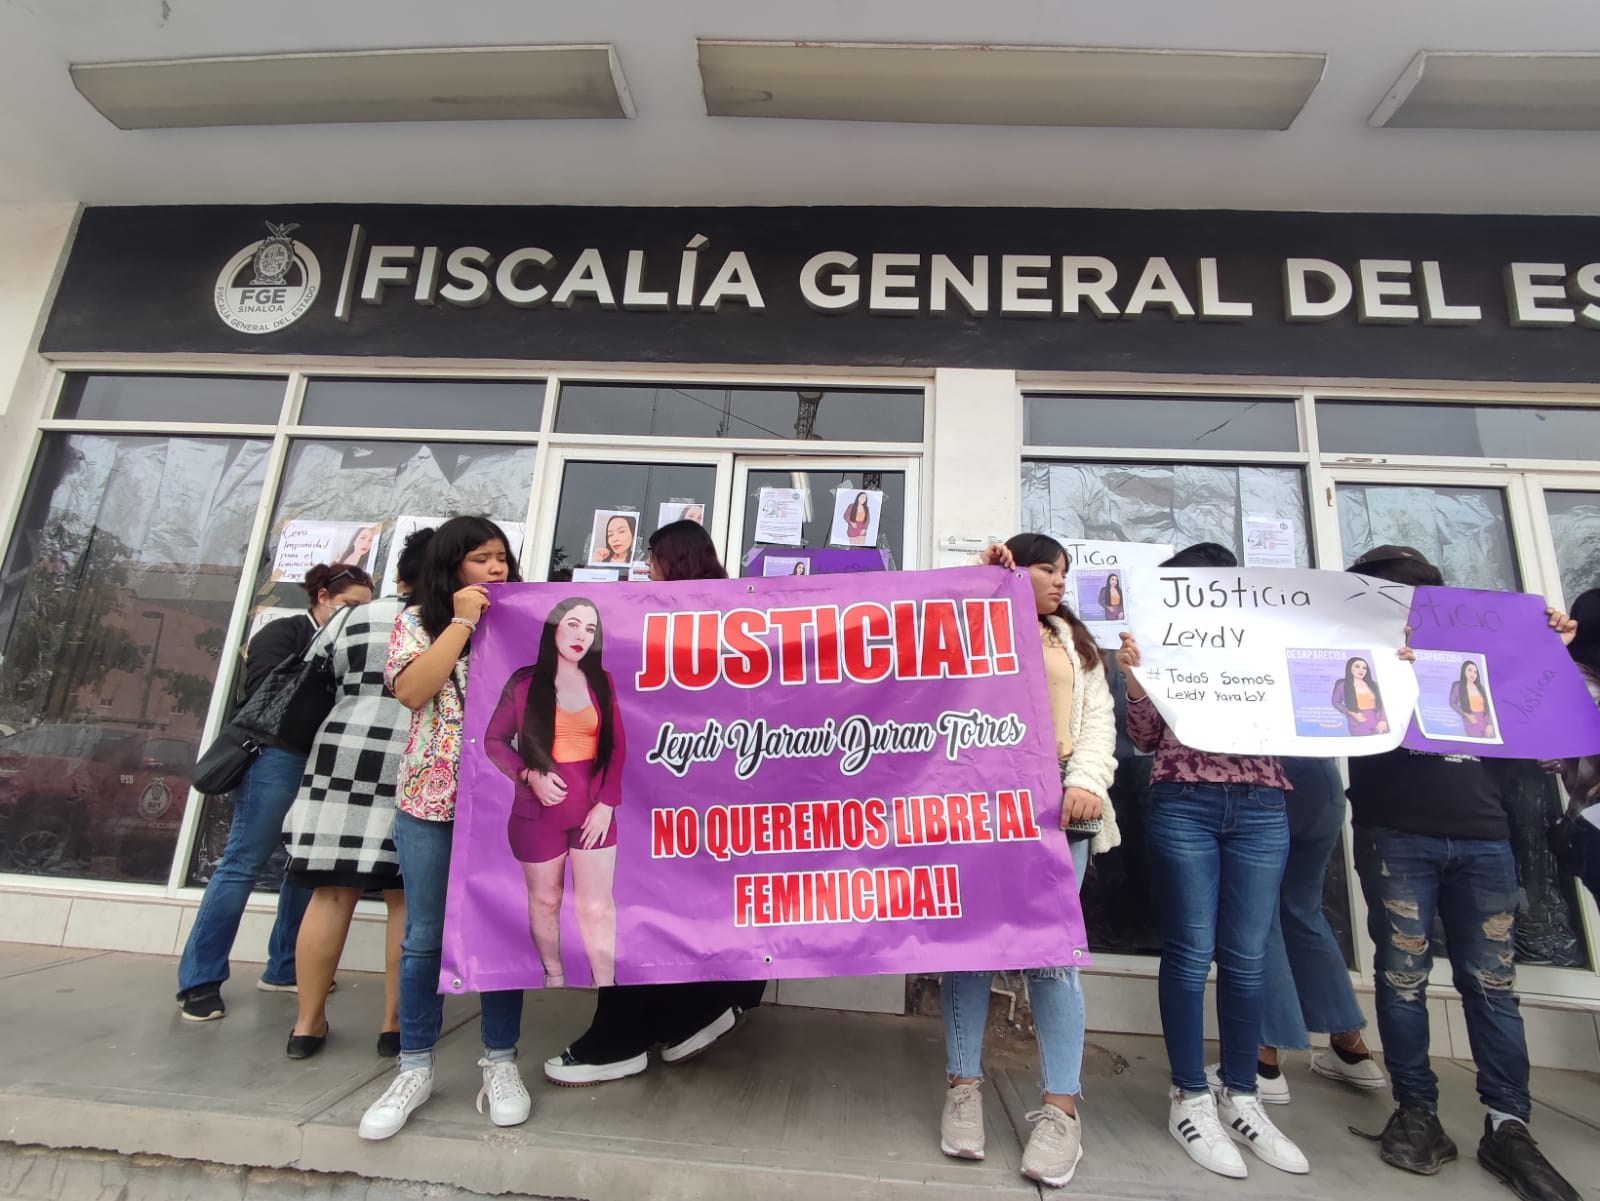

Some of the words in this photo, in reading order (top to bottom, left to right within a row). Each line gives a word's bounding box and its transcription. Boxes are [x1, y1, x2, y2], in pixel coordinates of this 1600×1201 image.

[240, 289, 287, 305] FGE
[361, 233, 766, 311] FISCALÍA
[798, 250, 1253, 321] GENERAL
[1283, 257, 1482, 326] DEL
[230, 319, 270, 331] GENERAL
[273, 317, 291, 328] DEL
[292, 286, 316, 317] ESTADO
[237, 304, 284, 313] SINALOA
[282, 523, 309, 539] Cero
[635, 598, 1020, 692] JUSTICIA!!
[1162, 622, 1245, 649] Leydy
[1165, 668, 1209, 684] Todos
[645, 718, 725, 778] Leydi
[839, 713, 935, 778] Duran
[938, 707, 1027, 761] Torres
[650, 806, 702, 859] NO
[703, 796, 889, 861] QUEREMOS
[893, 792, 993, 848] LIBRE
[995, 788, 1041, 842] AL
[733, 864, 963, 927] FEMINICIDA!!
